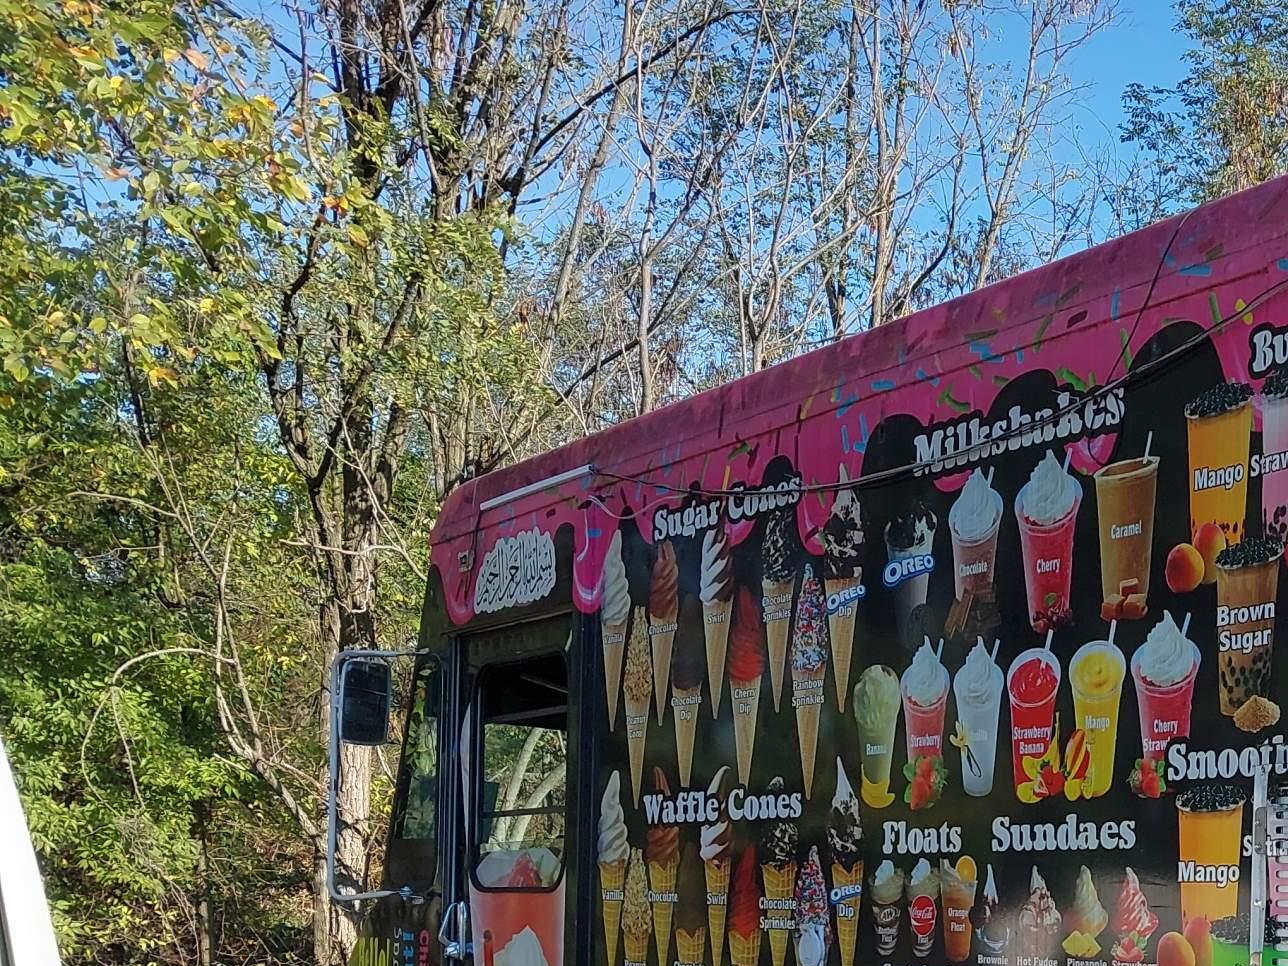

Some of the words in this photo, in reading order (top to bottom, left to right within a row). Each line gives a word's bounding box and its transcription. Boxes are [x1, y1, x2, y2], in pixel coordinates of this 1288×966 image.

[913, 387, 1125, 476] Milkshakes
[1193, 466, 1244, 491] Mango
[654, 500, 720, 540] Sugar
[727, 475, 801, 519] Cones
[1110, 520, 1143, 540] Caramel
[884, 555, 934, 583] OREO
[1036, 557, 1061, 576] Cherry
[827, 585, 866, 610] OREO
[762, 608, 792, 623] Sprinkles
[838, 606, 852, 618] Dip
[1217, 603, 1275, 627] Brown
[1219, 629, 1271, 654] Sugar
[792, 694, 825, 707] Sprinkles
[739, 703, 751, 714] Dip
[1085, 715, 1110, 731] Mango
[1153, 719, 1178, 734] Cherry
[1013, 726, 1050, 741] Strawberry
[911, 734, 941, 749] Strawberry
[1019, 742, 1044, 754] Banana
[644, 790, 719, 824] Waffle
[728, 788, 802, 820] Cones
[882, 821, 962, 855] Floats
[992, 813, 1136, 851] Sundaes
[1178, 862, 1240, 888] Mango
[648, 891, 678, 902] Chocolate
[707, 893, 727, 905] Swirl
[830, 885, 862, 901] OREO
[759, 897, 796, 909] Chocolate
[838, 904, 854, 918] Dip
[760, 917, 795, 931] Sprinkles
[977, 954, 1008, 965] Brownie
[1016, 956, 1031, 966] Hot
